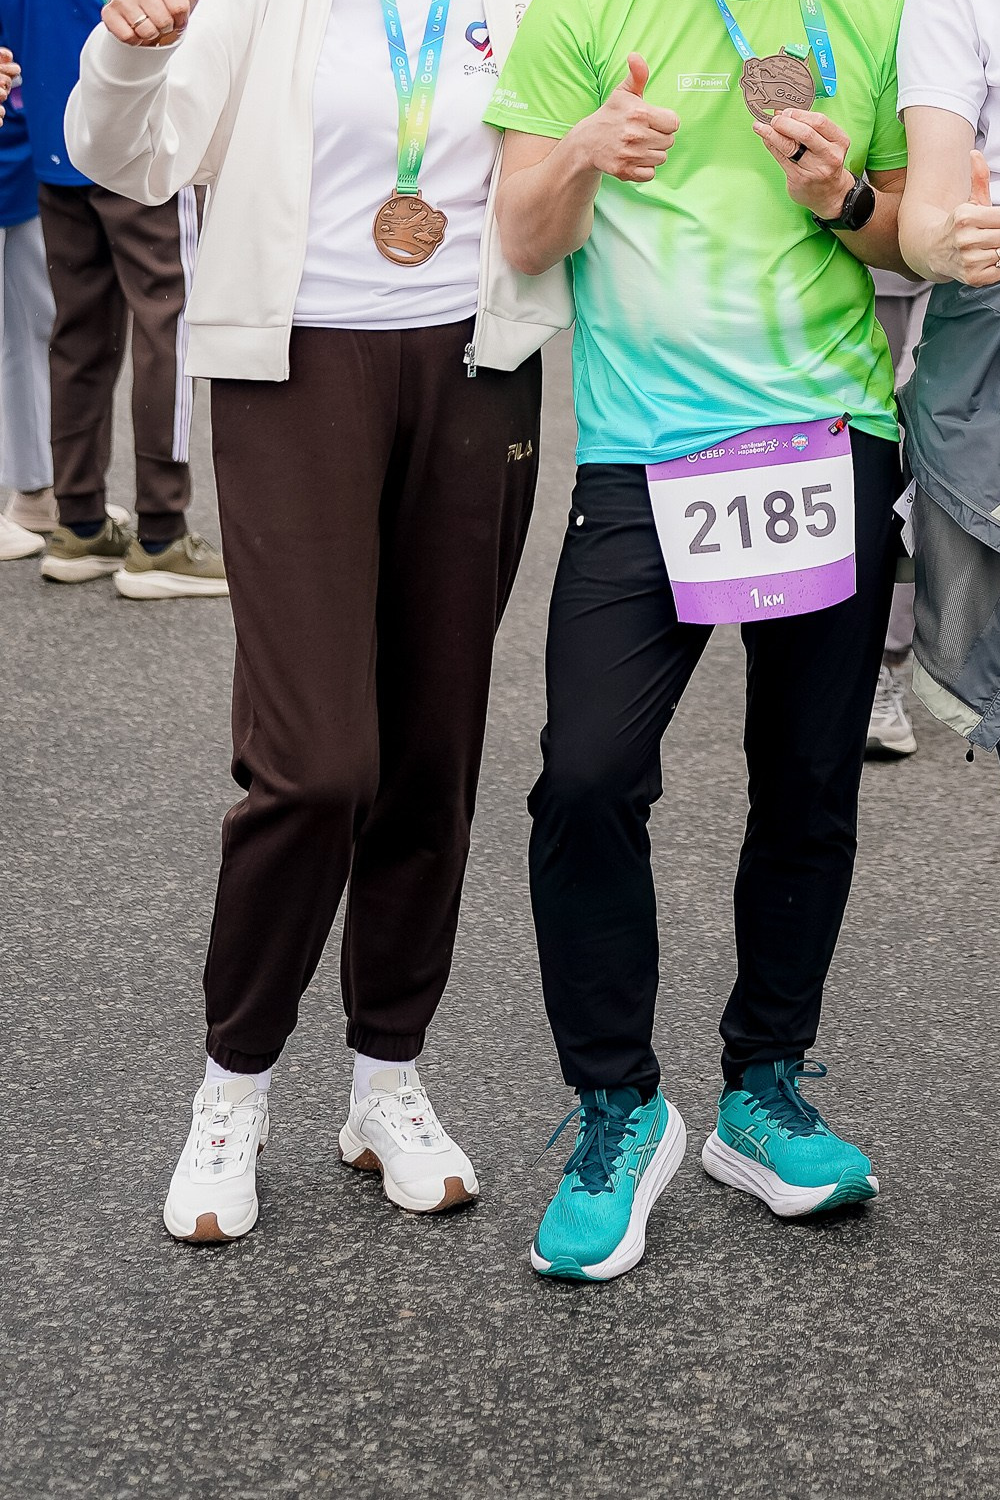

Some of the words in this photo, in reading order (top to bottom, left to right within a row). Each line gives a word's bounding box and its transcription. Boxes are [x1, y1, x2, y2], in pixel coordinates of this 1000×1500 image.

[818, 49, 828, 69] Utair
[694, 77, 723, 88] Прайм
[700, 448, 726, 460] СБЕР
[684, 483, 837, 555] 2185
